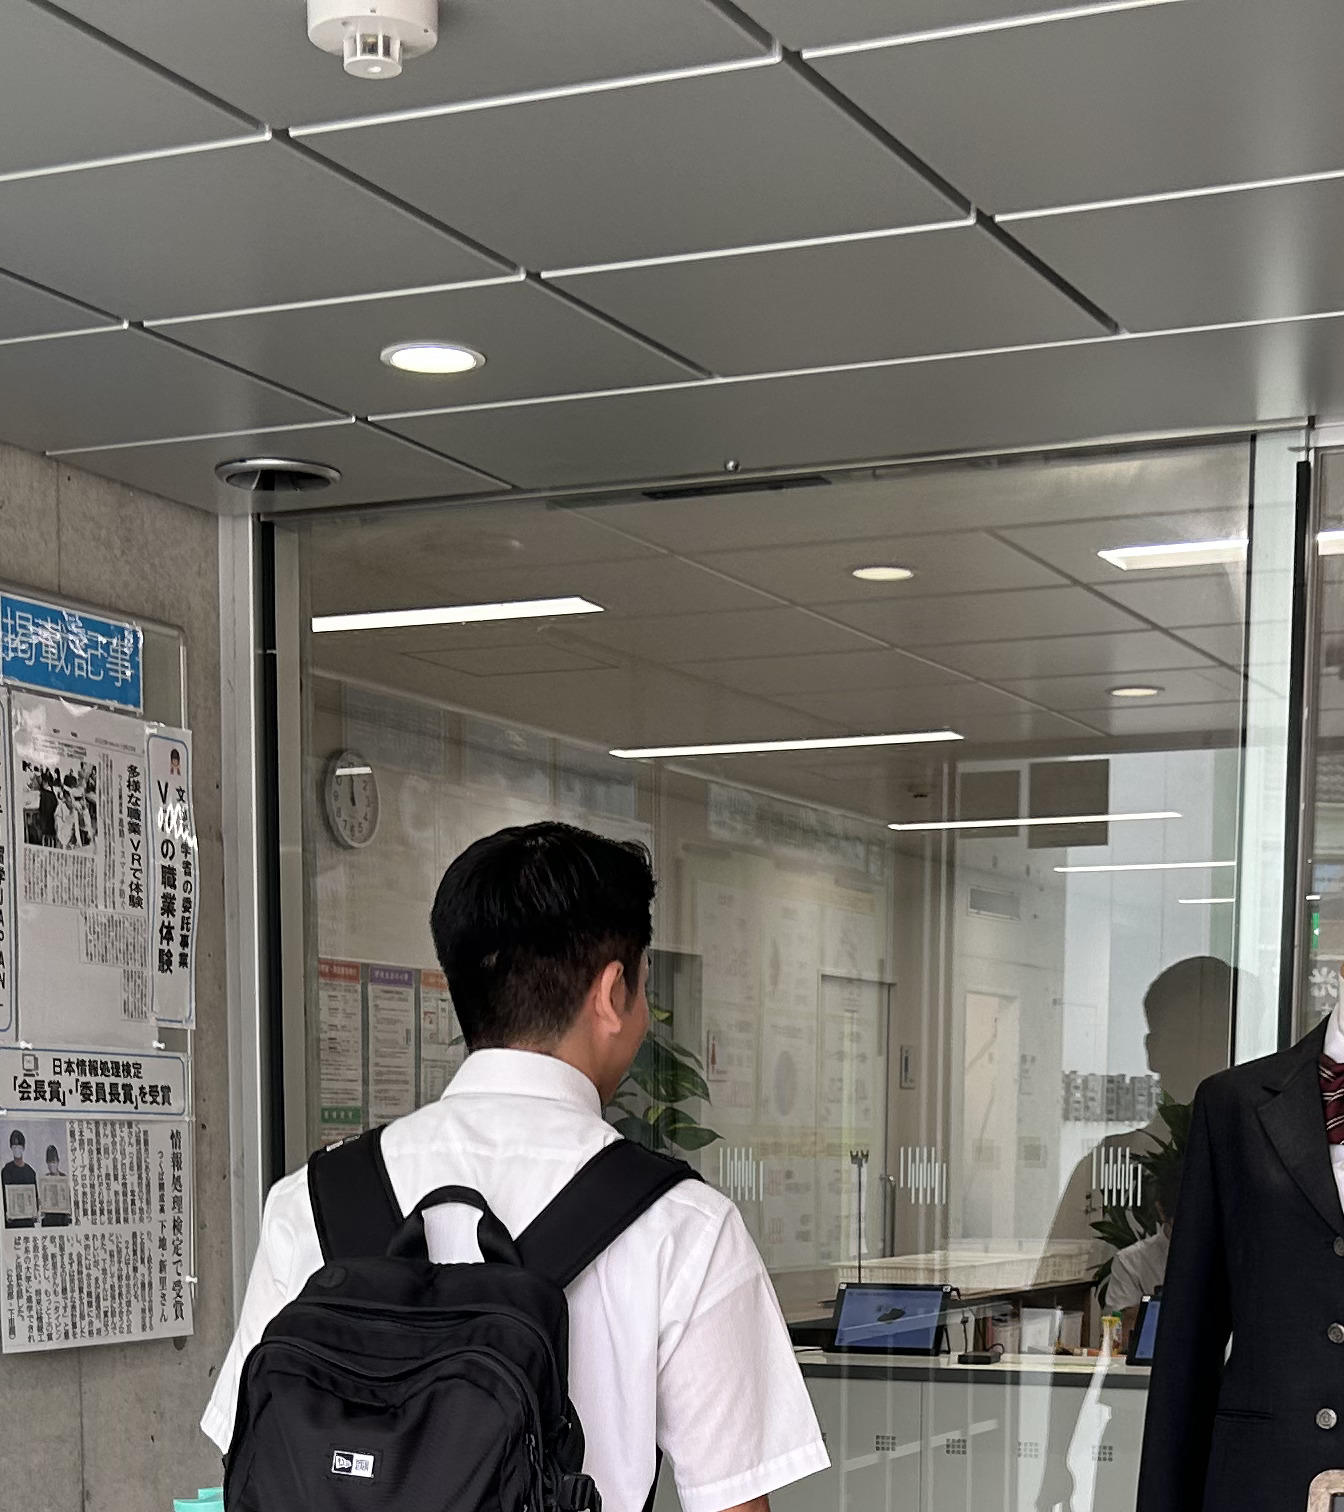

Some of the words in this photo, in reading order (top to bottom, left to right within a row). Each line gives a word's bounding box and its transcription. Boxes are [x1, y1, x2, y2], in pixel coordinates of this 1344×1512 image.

[2, 606, 136, 688] 掲載記事
[52, 1057, 143, 1079] 日本情報処理検定
[170, 1129, 185, 1322] 情報処理検定で受賞
